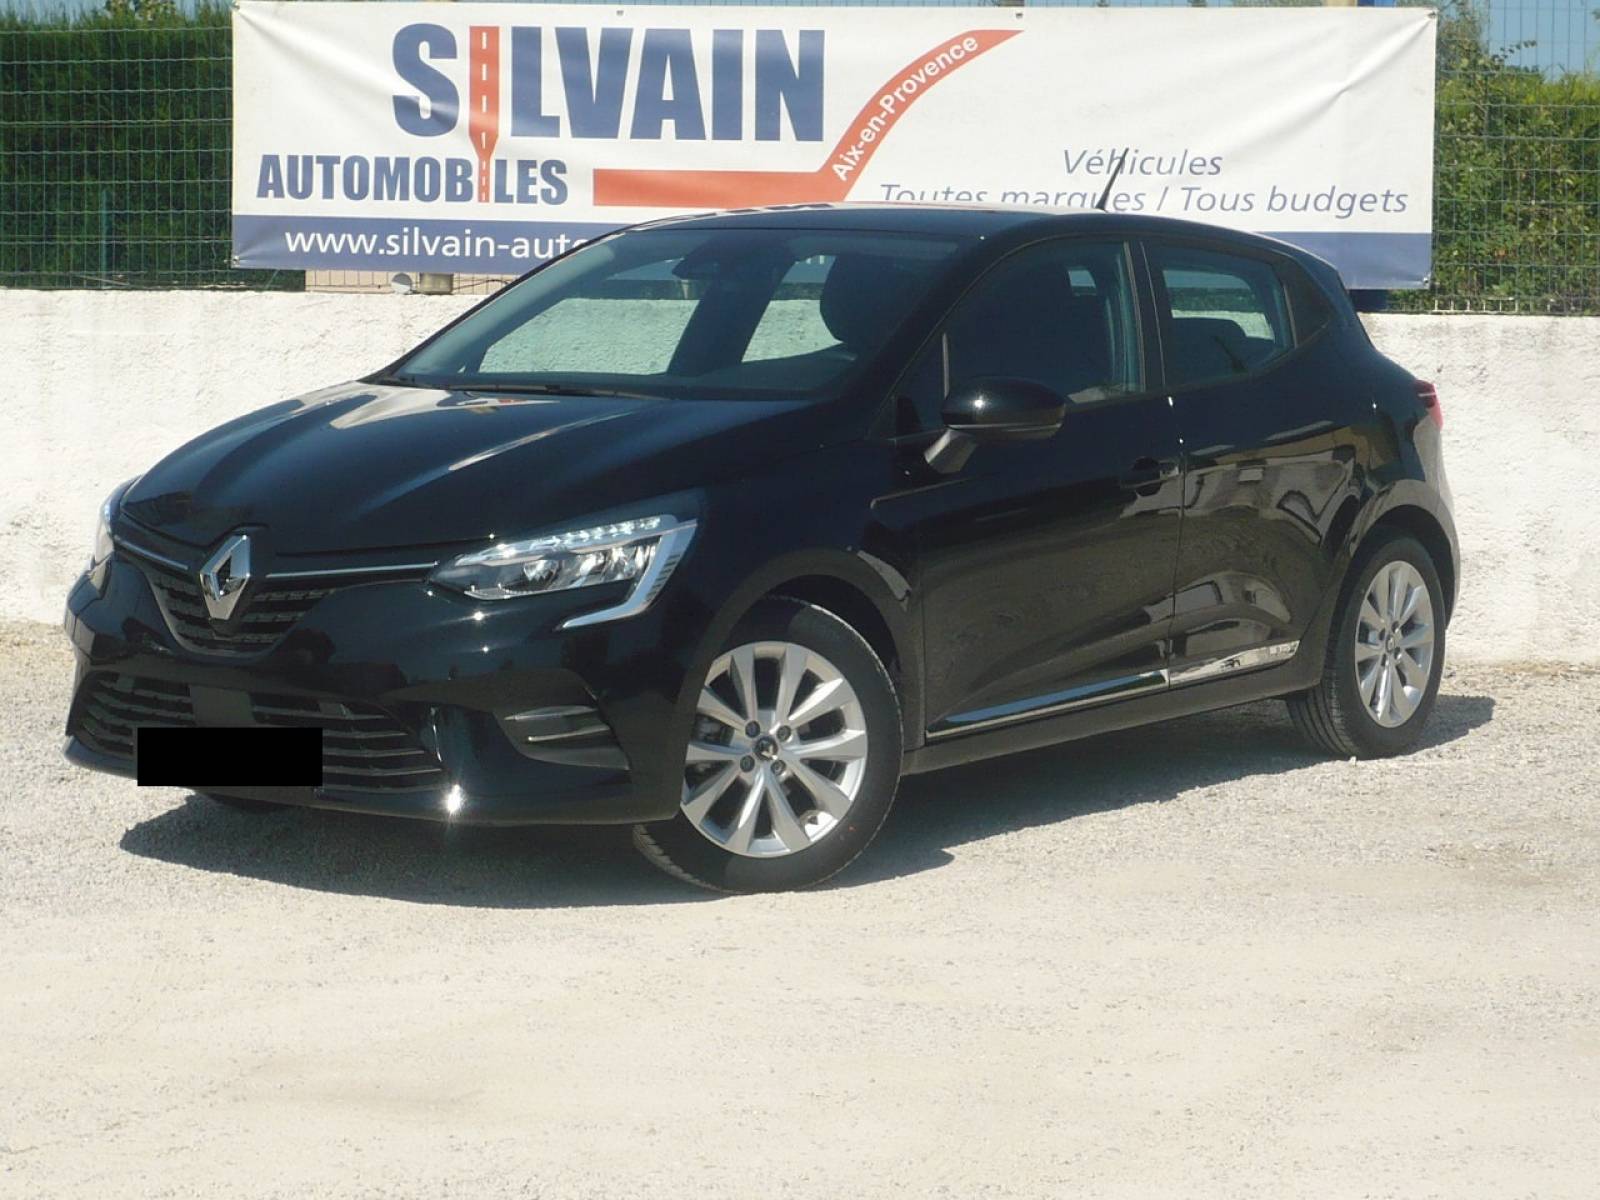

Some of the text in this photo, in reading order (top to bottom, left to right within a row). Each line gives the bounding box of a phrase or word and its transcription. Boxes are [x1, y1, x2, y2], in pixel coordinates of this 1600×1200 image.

[392, 23, 824, 141] SILVAIN
[832, 37, 978, 181] Aix-en-Provence
[256, 154, 568, 205] AUTOMOBILES
[1064, 149, 1222, 175] Véhicules
[1181, 187, 1255, 212] Tous
[1267, 185, 1409, 219] budgets
